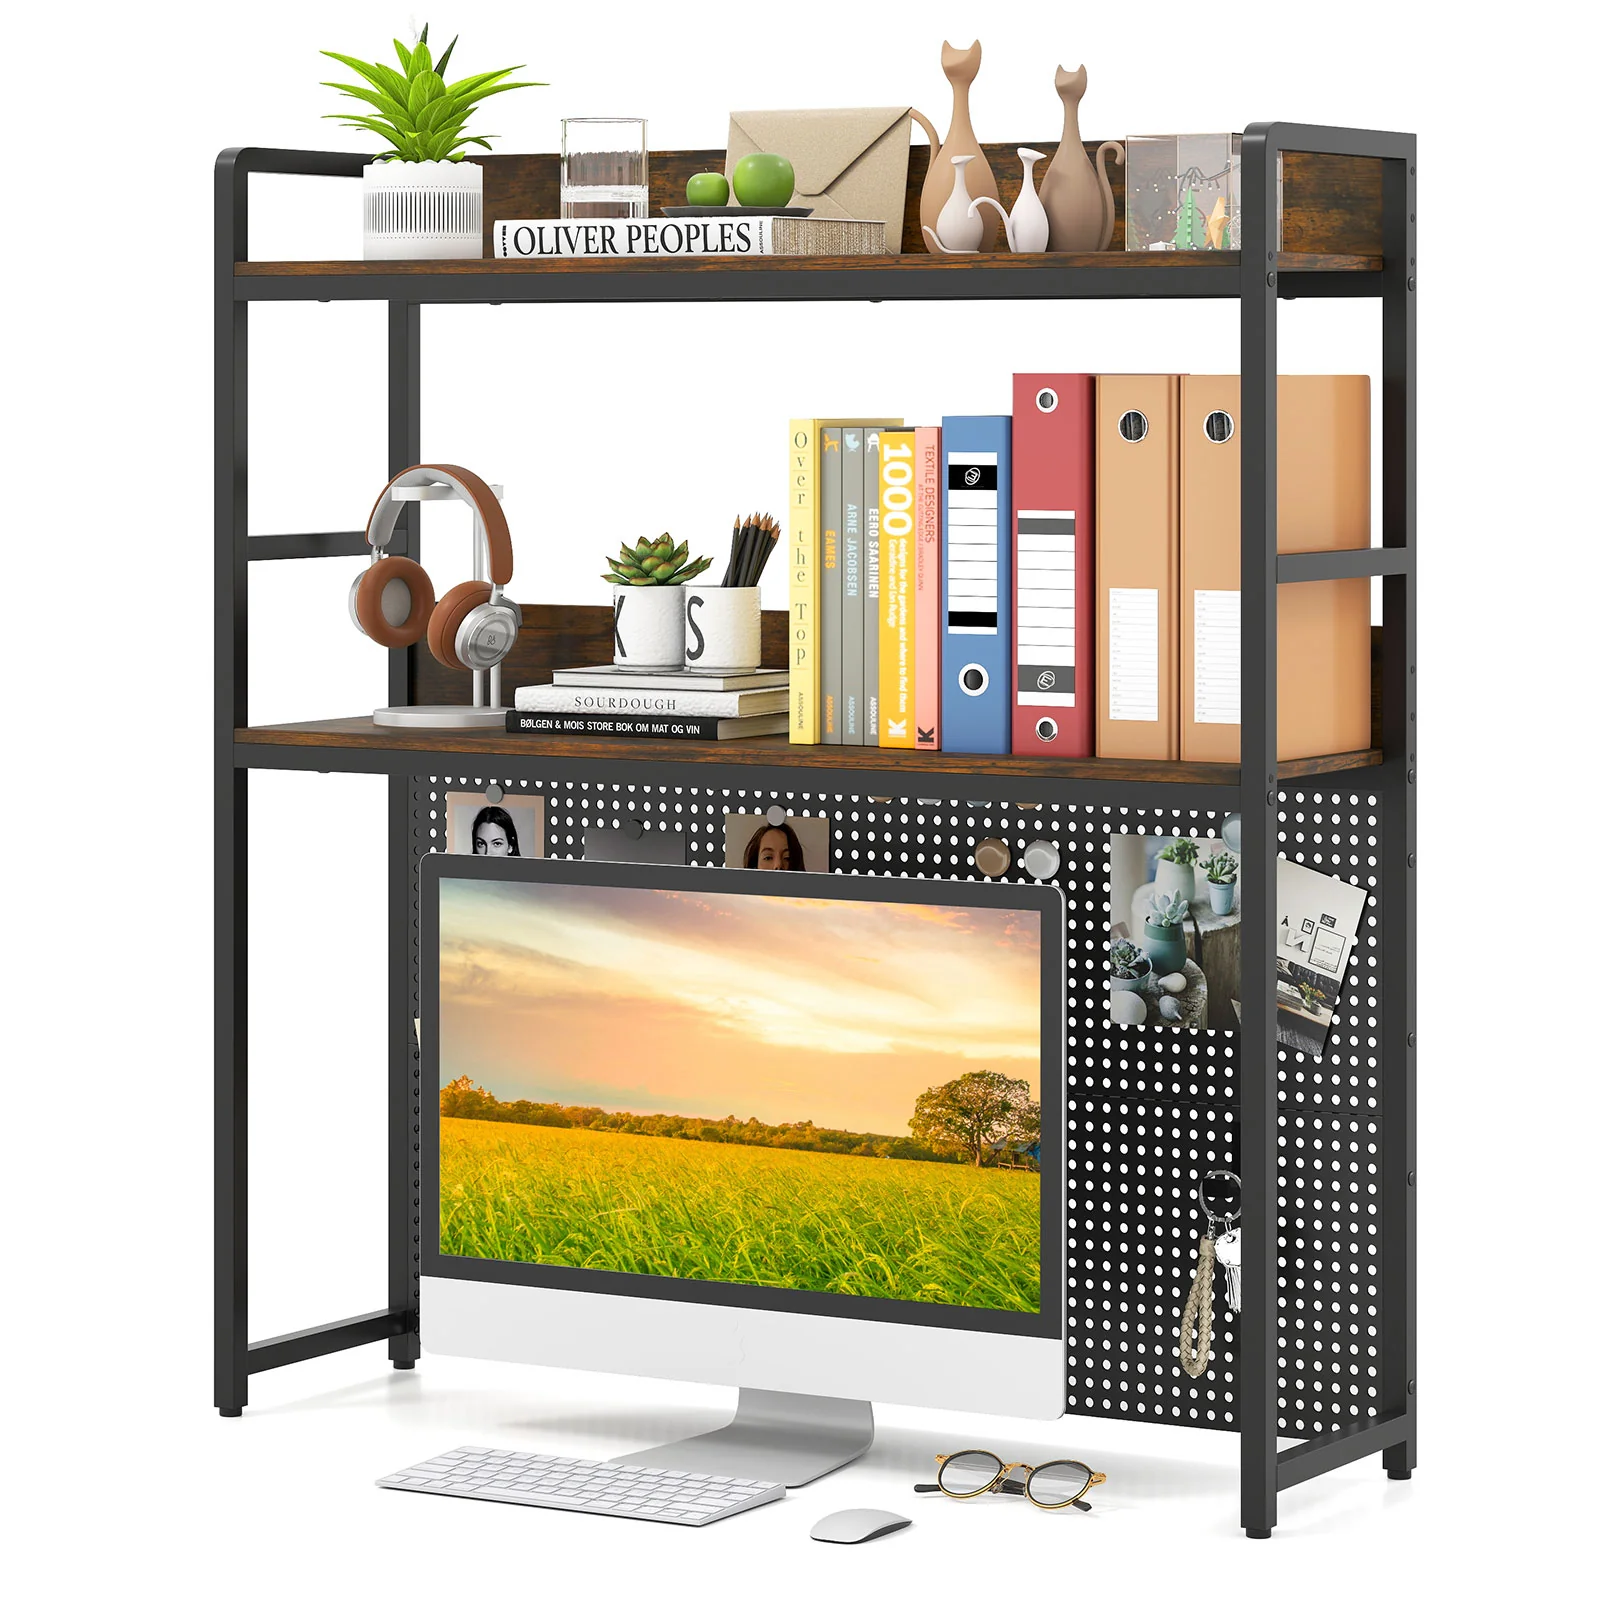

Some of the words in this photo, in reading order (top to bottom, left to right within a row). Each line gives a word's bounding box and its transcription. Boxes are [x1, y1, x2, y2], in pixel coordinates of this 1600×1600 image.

[513, 224, 617, 255] OLIVER
[626, 222, 751, 254] PEOPLES
[925, 445, 935, 484] TEXTILE
[883, 443, 913, 536] 1000
[847, 503, 858, 534] ARNE
[868, 508, 879, 537] EERO
[925, 487, 935, 543] DESIGNERS
[824, 529, 836, 569] EAMES
[847, 539, 858, 596] JACOBSEN
[868, 542, 879, 598] SAARINEN
[686, 596, 705, 661] S
[574, 696, 676, 711] SOURDOUGH
[520, 718, 553, 729] BØLGEN
[554, 719, 562, 729] &
[563, 720, 584, 730] MOIS
[587, 721, 614, 731] STORE
[616, 721, 633, 732] BOK
[635, 722, 649, 732] OM
[651, 723, 669, 733] MAT
[671, 724, 684, 734] OG
[686, 725, 700, 735] VIN
